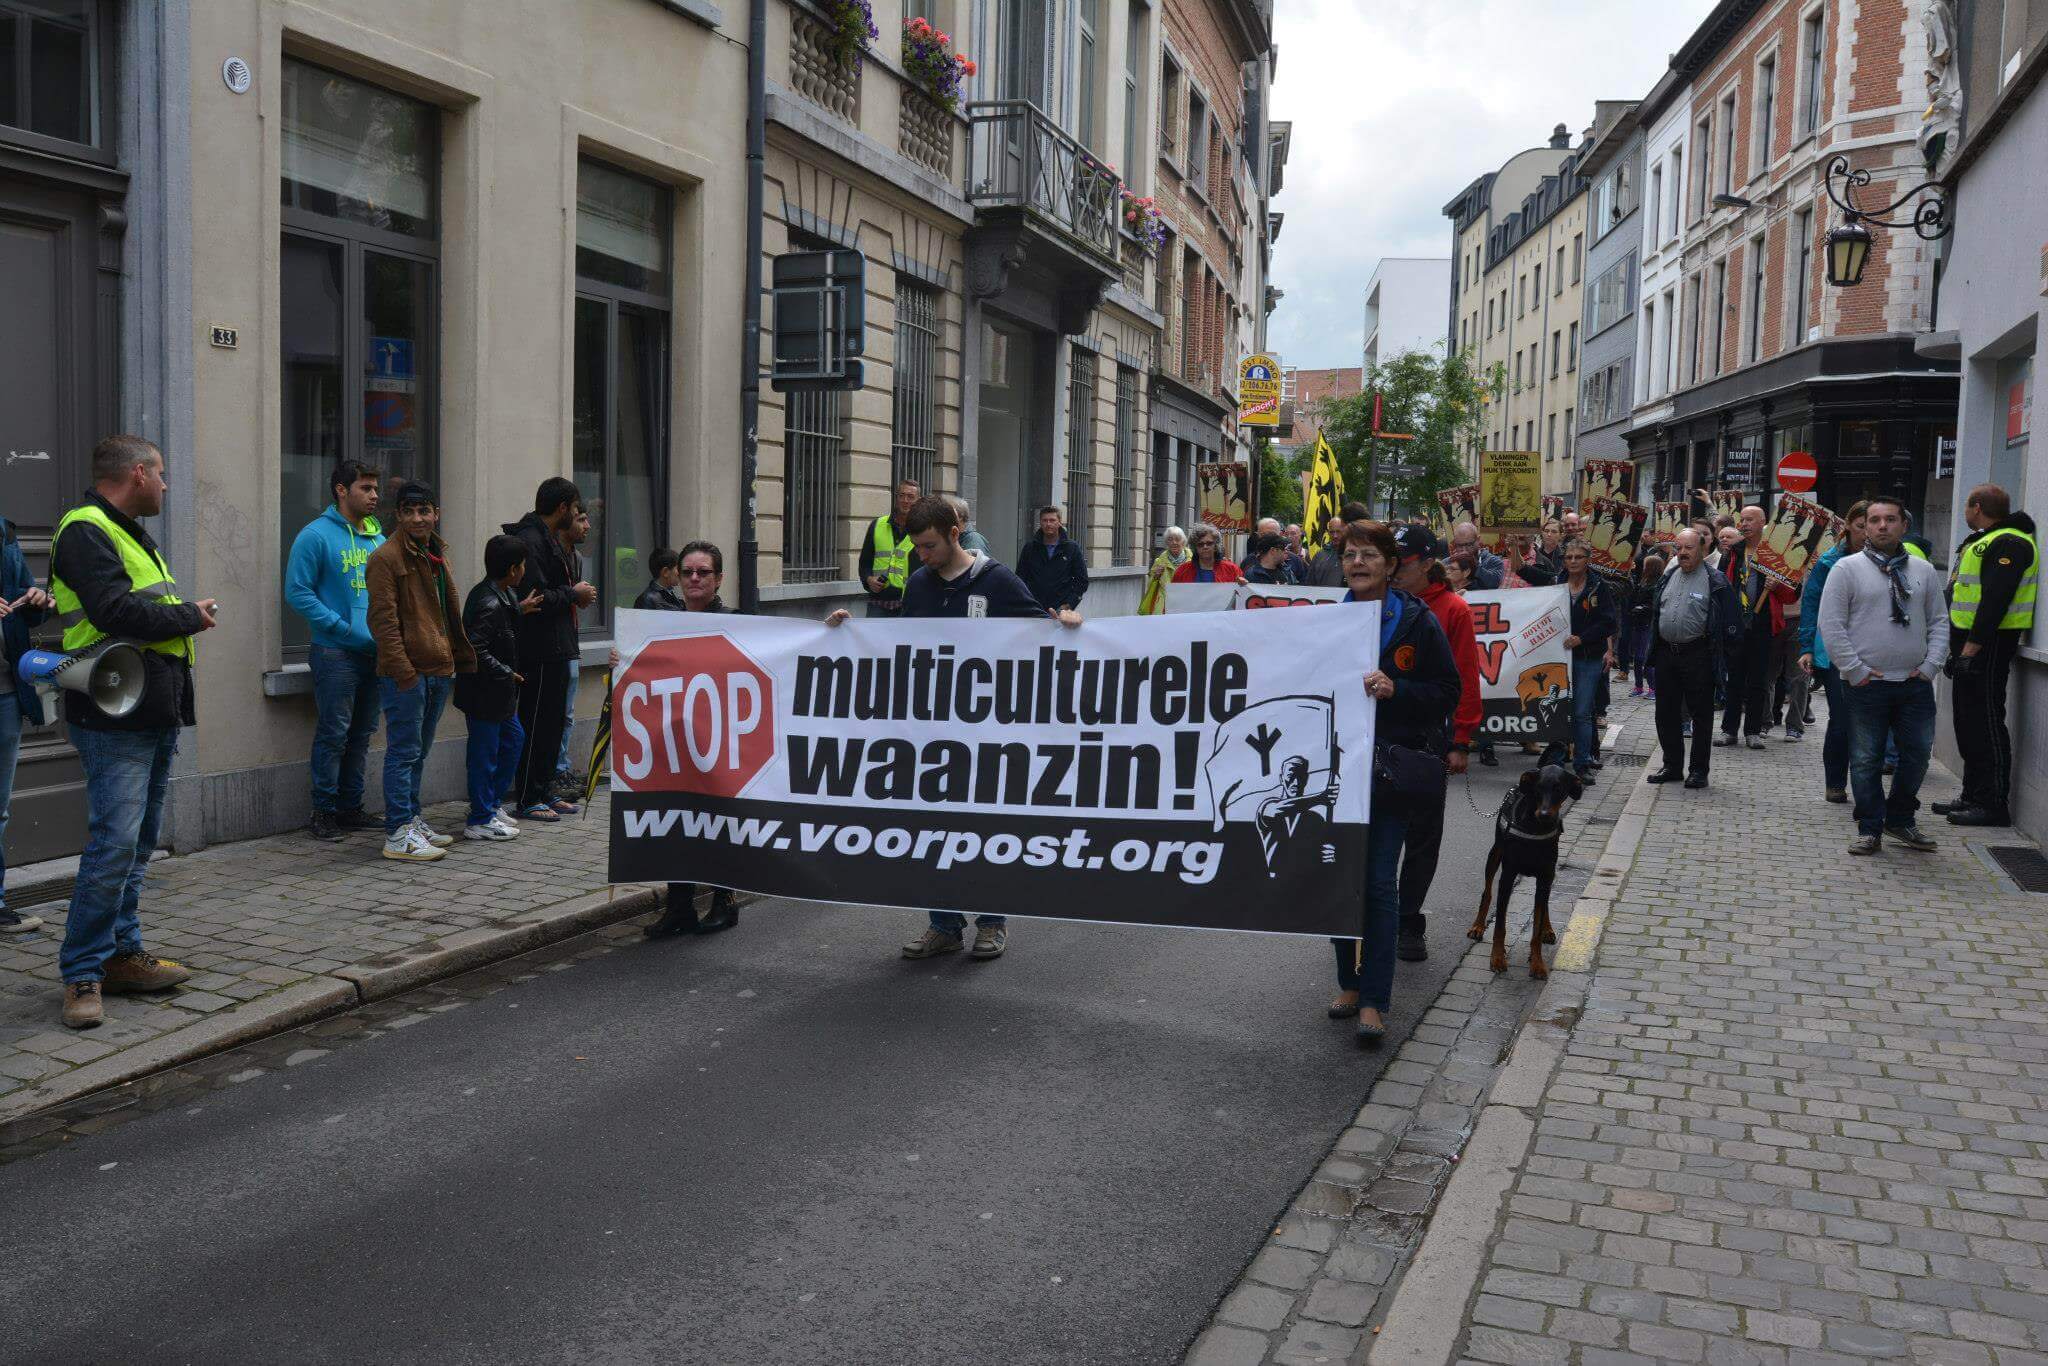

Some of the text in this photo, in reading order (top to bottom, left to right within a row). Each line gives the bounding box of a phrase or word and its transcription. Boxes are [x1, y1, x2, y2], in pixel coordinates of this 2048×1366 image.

[218, 330, 232, 344] 33
[1259, 358, 1278, 379] IMMO
[1521, 616, 1553, 640] BOYCOT
[1529, 625, 1557, 646] HALAL
[792, 641, 1248, 725] multiculturele
[622, 671, 761, 782] STOP
[787, 731, 1200, 811] waanzin!
[623, 810, 1225, 885] www.voorpost.org
